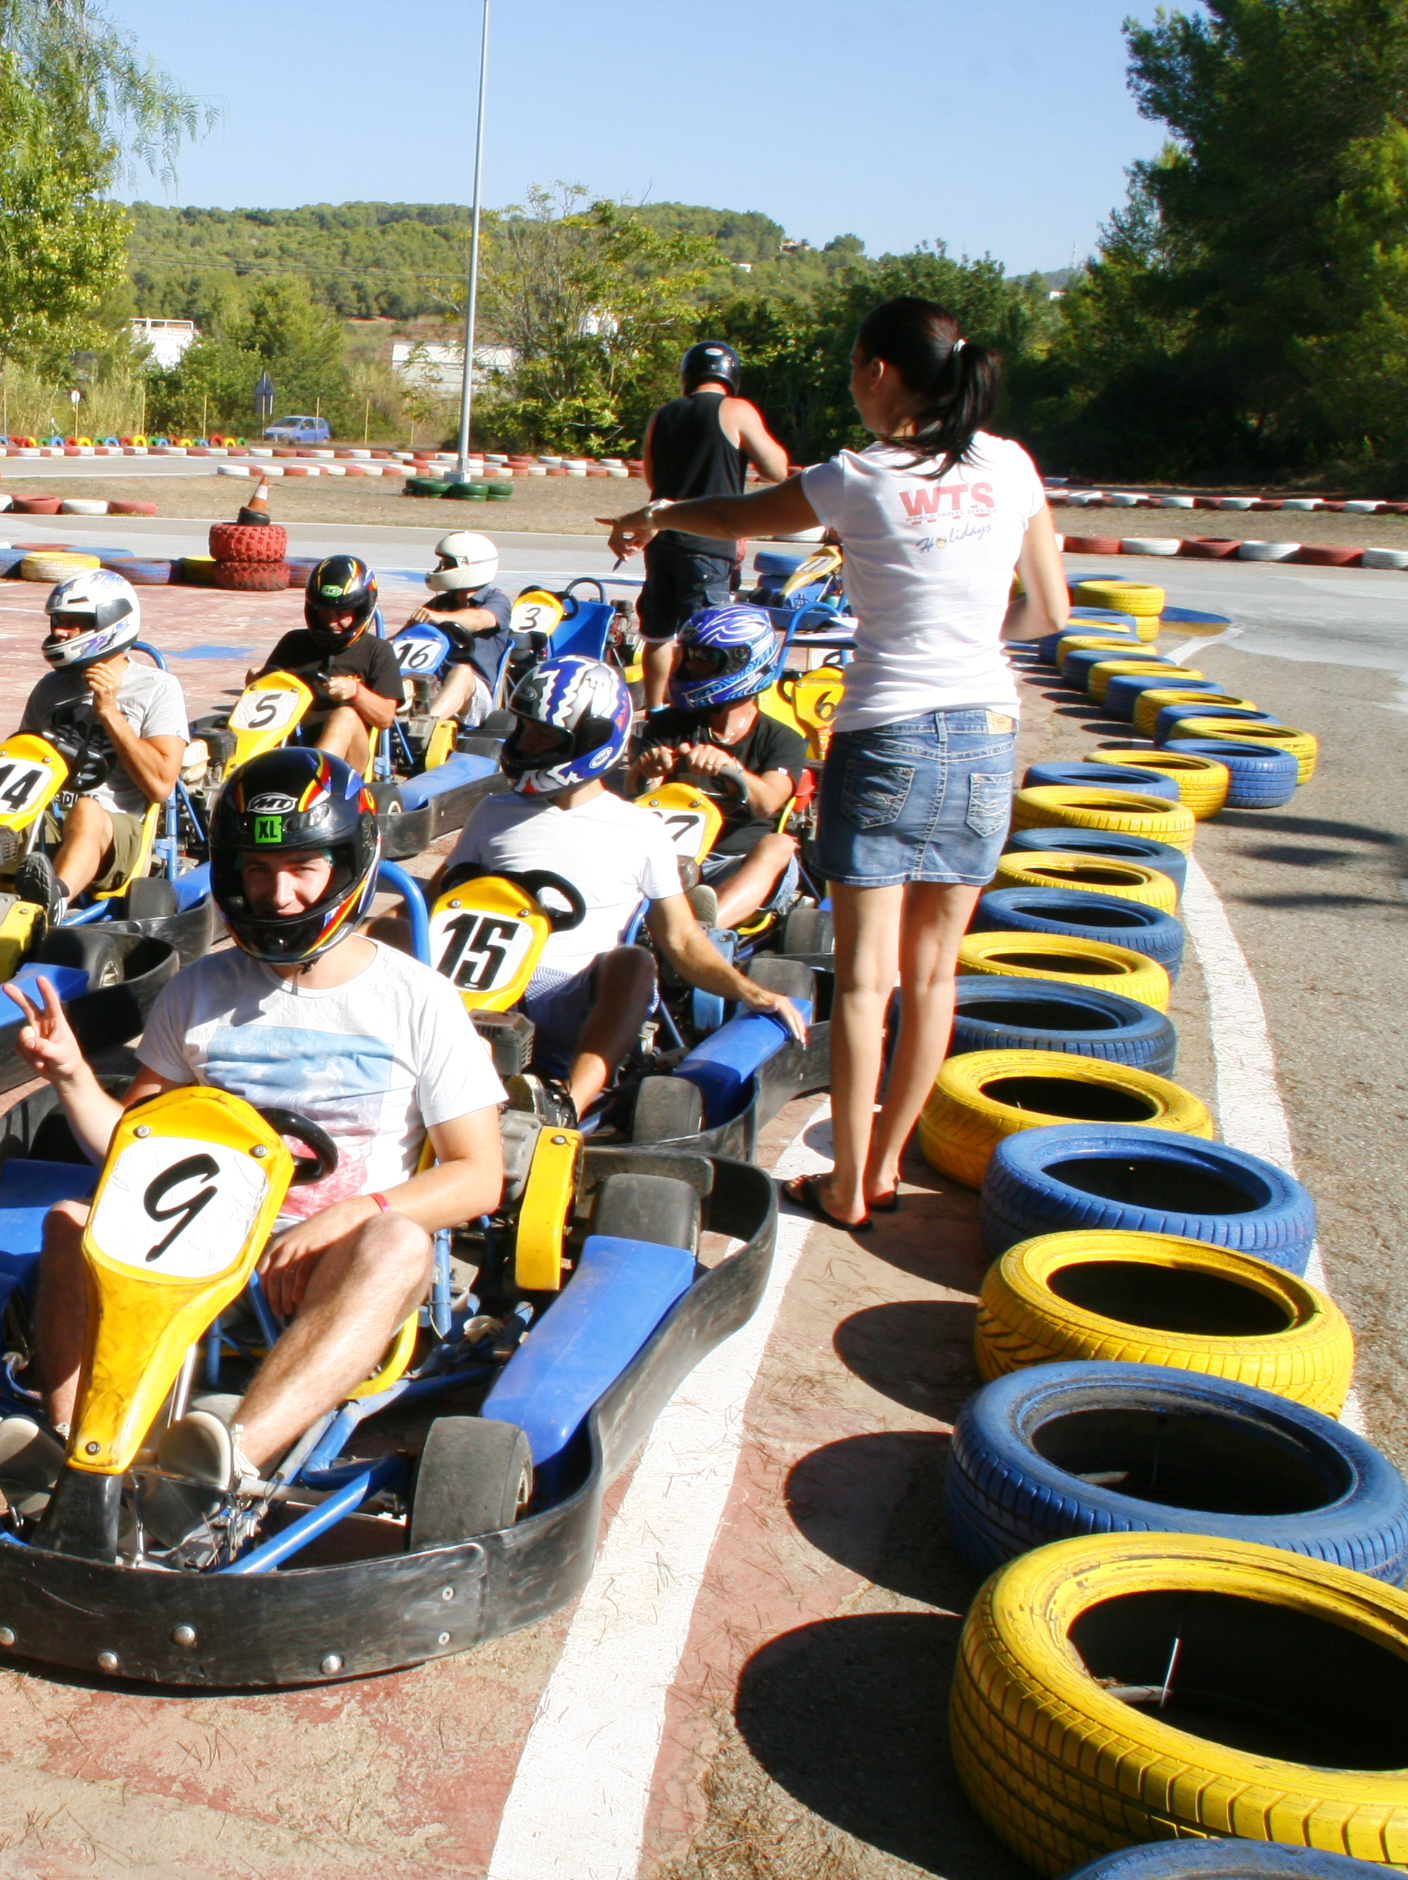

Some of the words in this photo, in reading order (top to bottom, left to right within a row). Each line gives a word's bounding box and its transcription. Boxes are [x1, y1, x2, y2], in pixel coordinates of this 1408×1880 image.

[898, 482, 995, 525] WTS
[905, 513, 935, 522] WORLD
[937, 510, 965, 518] TRAVEL
[519, 607, 541, 630] 3
[395, 643, 434, 669] 16
[248, 693, 282, 729] 5
[814, 691, 836, 722] 6
[258, 820, 278, 839] XL
[436, 913, 520, 991] 15
[144, 1153, 220, 1262] 9
